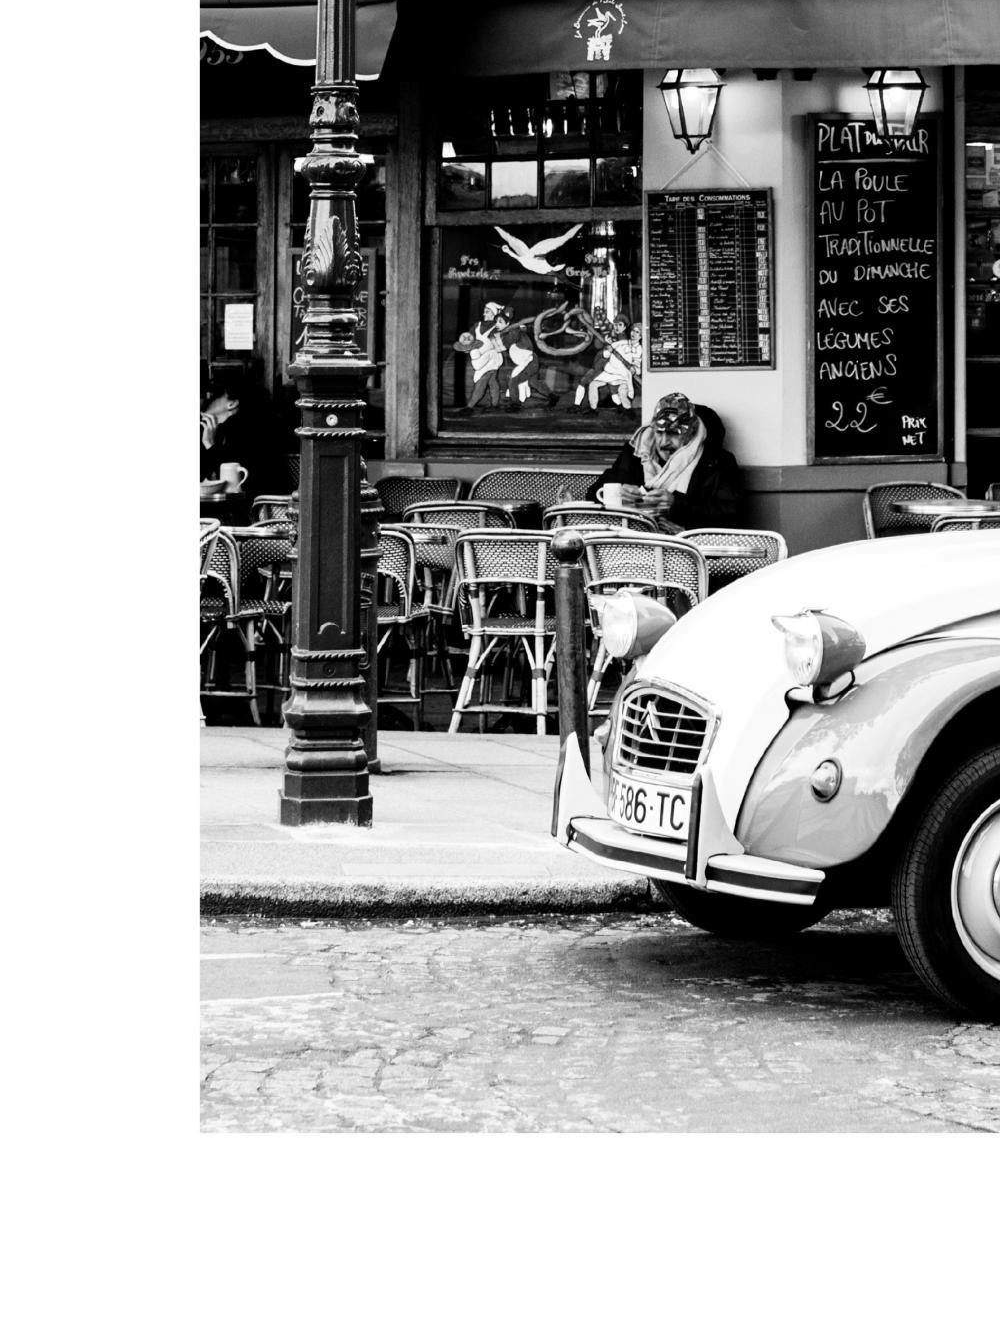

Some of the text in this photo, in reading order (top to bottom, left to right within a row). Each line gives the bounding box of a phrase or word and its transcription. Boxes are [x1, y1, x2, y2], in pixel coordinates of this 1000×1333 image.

[818, 122, 866, 154] PLAT
[819, 167, 912, 192] LA POULE
[698, 194, 751, 202] CONSOMMATIONS
[819, 198, 896, 225] AU POT
[818, 230, 935, 258] TRADITIONNELLE
[819, 262, 931, 285] DU DIMANCHE
[818, 295, 910, 318] AVEC SES
[817, 327, 894, 351] LÉGUMES
[819, 353, 897, 380] ANCIENS
[901, 415, 928, 429] PRIX
[901, 431, 926, 446] NET
